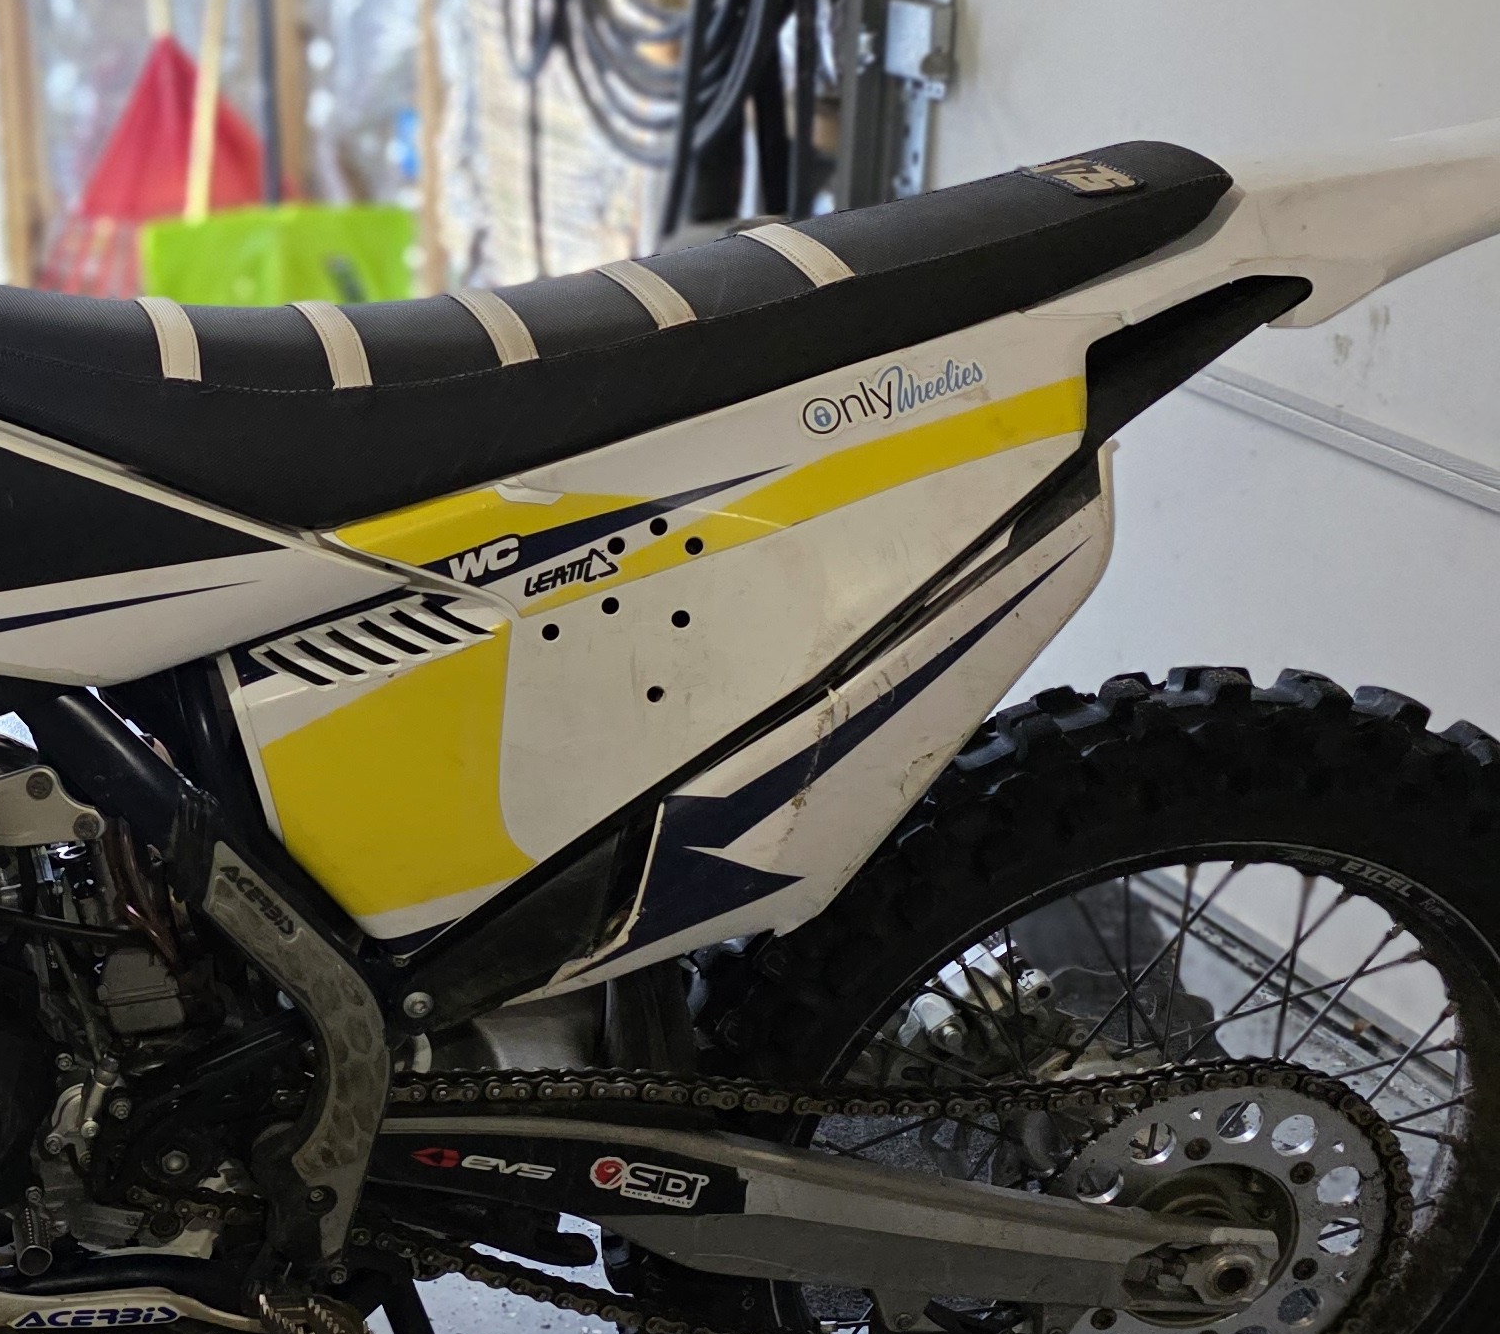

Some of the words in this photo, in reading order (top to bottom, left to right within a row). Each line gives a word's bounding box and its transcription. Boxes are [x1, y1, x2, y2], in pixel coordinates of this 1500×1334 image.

[448, 537, 520, 582] WC
[1340, 860, 1412, 898] EXCEL
[15, 1306, 178, 1328] ACERBIS
